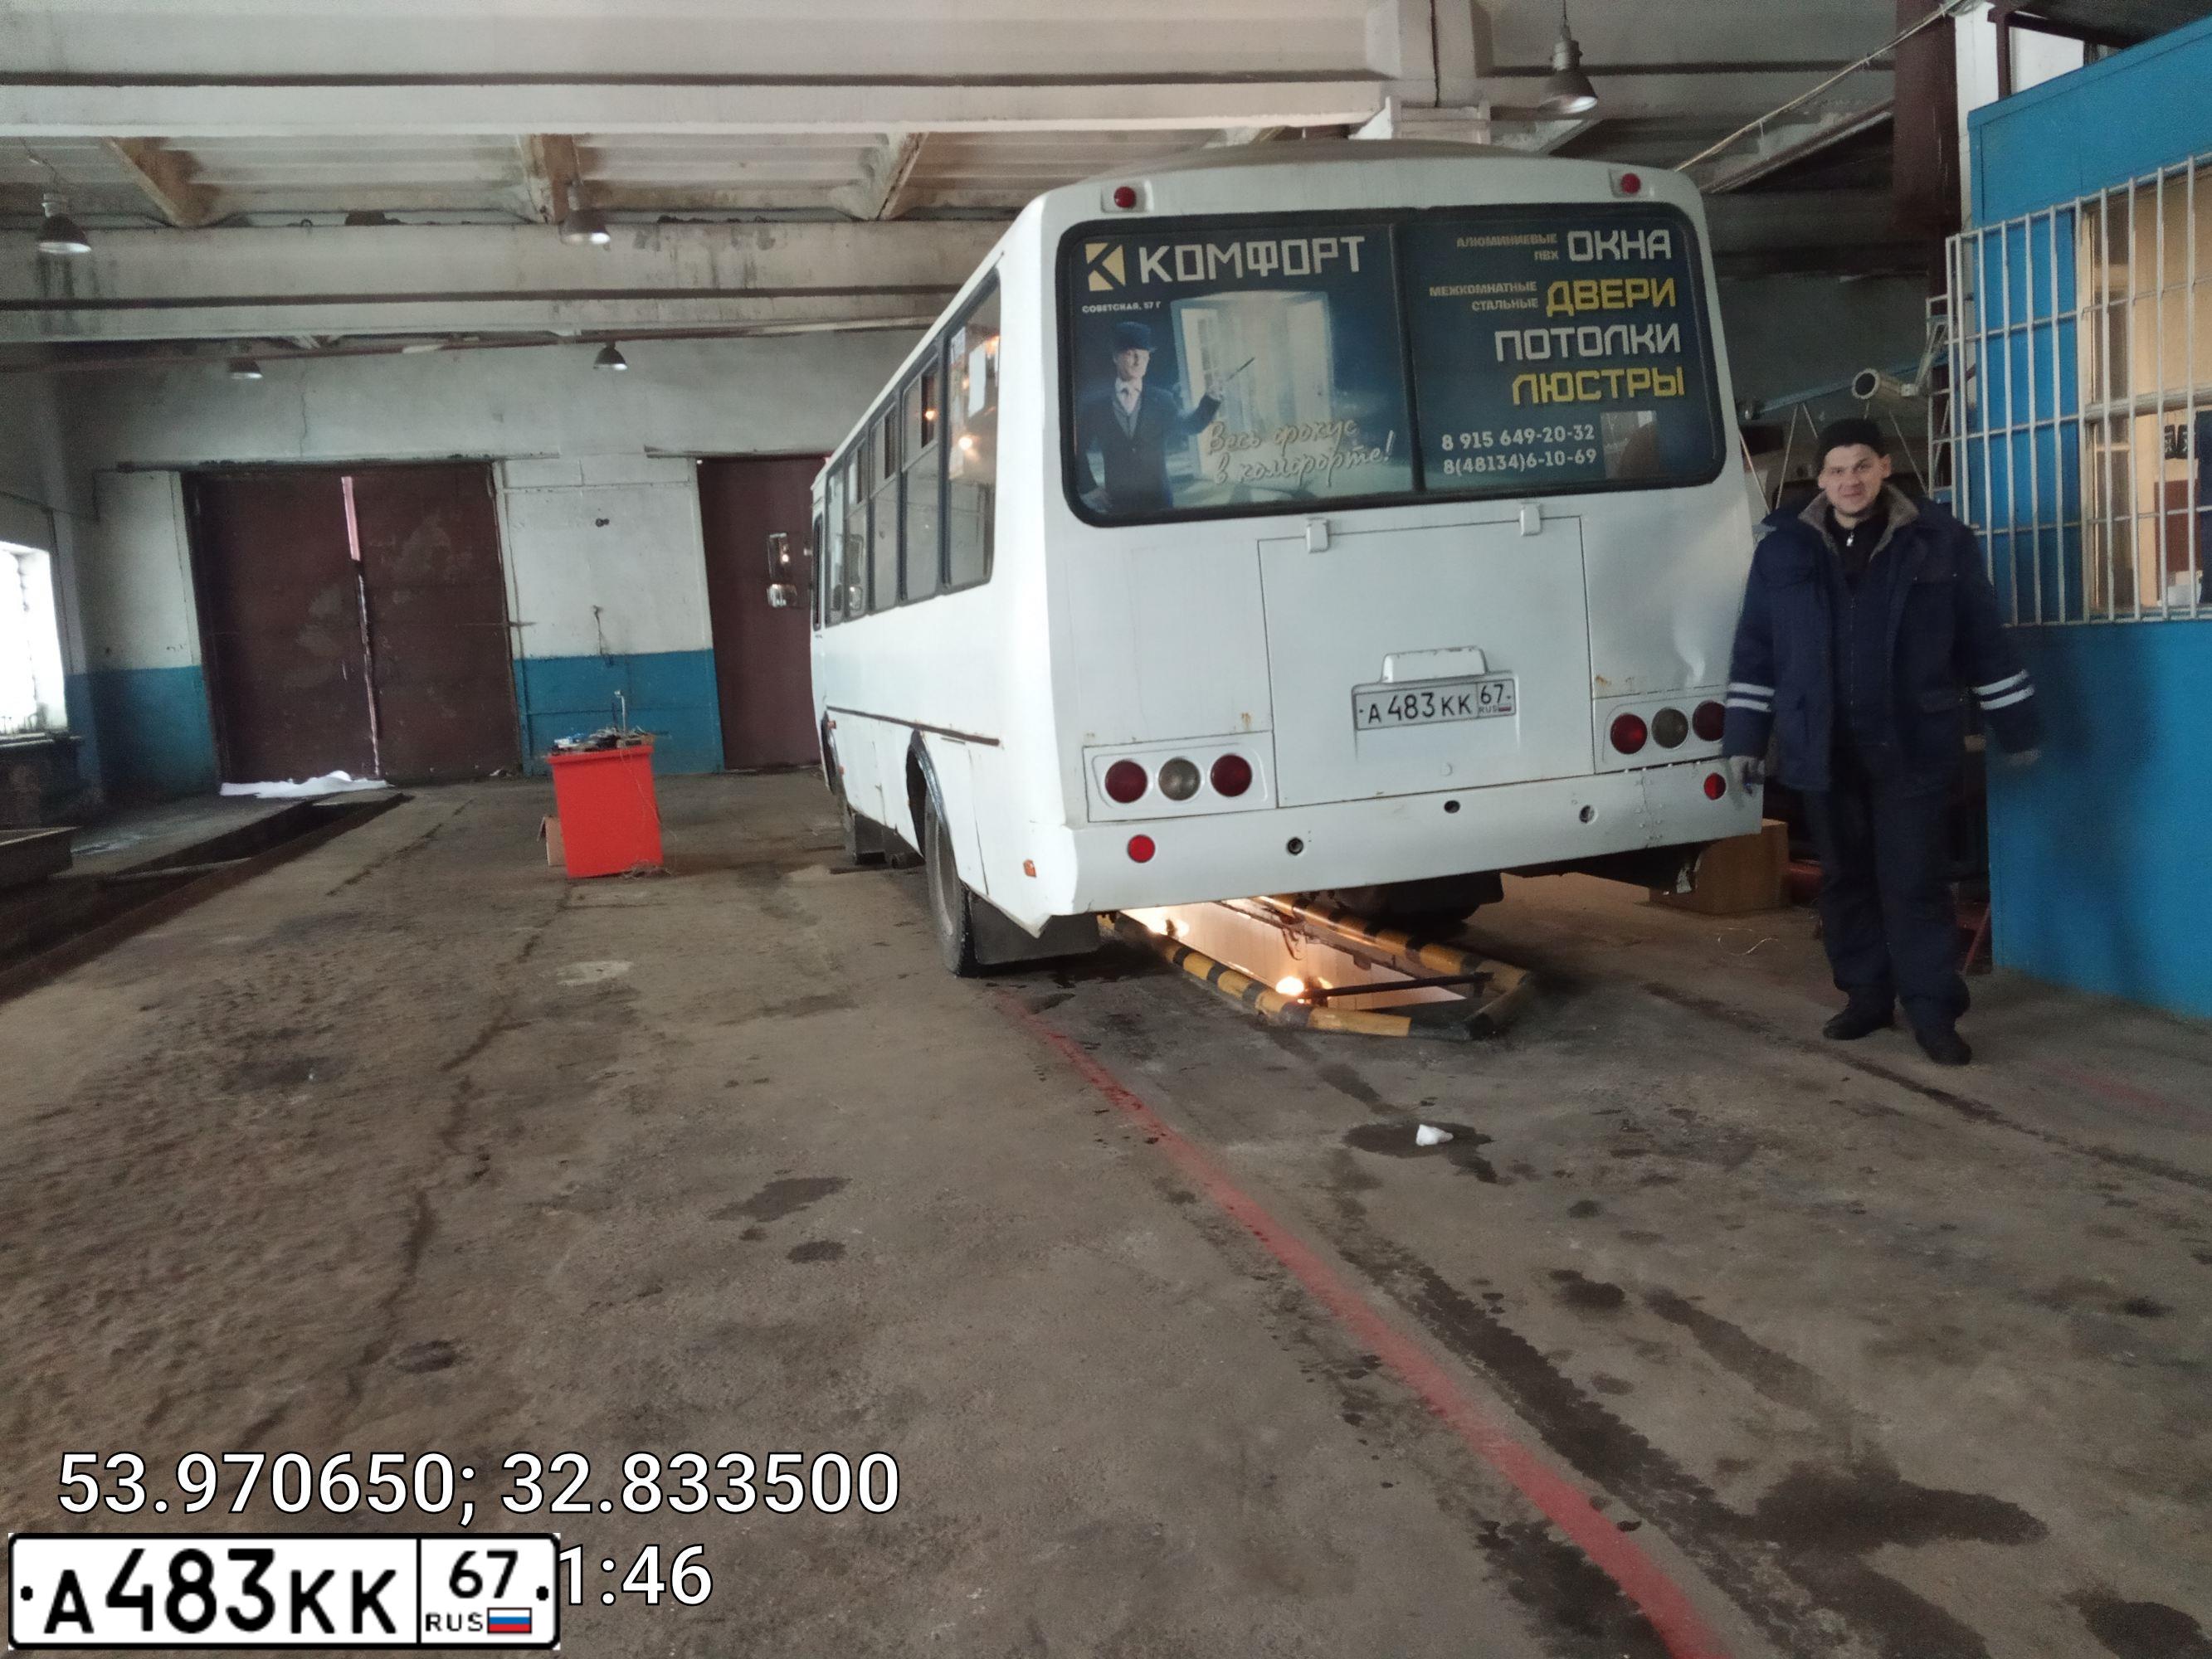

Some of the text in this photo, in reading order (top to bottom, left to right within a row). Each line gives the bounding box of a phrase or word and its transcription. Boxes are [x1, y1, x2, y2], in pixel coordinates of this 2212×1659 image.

[1456, 232, 1558, 247] АЛЮМИНИЕВЫЕ
[1567, 229, 1673, 262] ОКНА
[1139, 236, 1365, 284] КОМФОРТ
[1534, 250, 1559, 261] ПВХ
[1429, 280, 1537, 296] МЕЖКОМНАТНЫЕ
[1546, 278, 1677, 317] ДВЕРИ
[1471, 298, 1538, 312] СТАЛЬНЫЕ
[1494, 323, 1682, 362] ПОТОЛКИ
[1512, 366, 1685, 406] ЛЮСТРЫ
[1209, 418, 1358, 457] Весь фокус
[1442, 424, 1596, 451] 8 915 649-20-32
[1214, 429, 1396, 488] в комфорте!
[1443, 448, 1597, 477] 8(48134)6-10-69
[1480, 684, 1504, 705] 67
